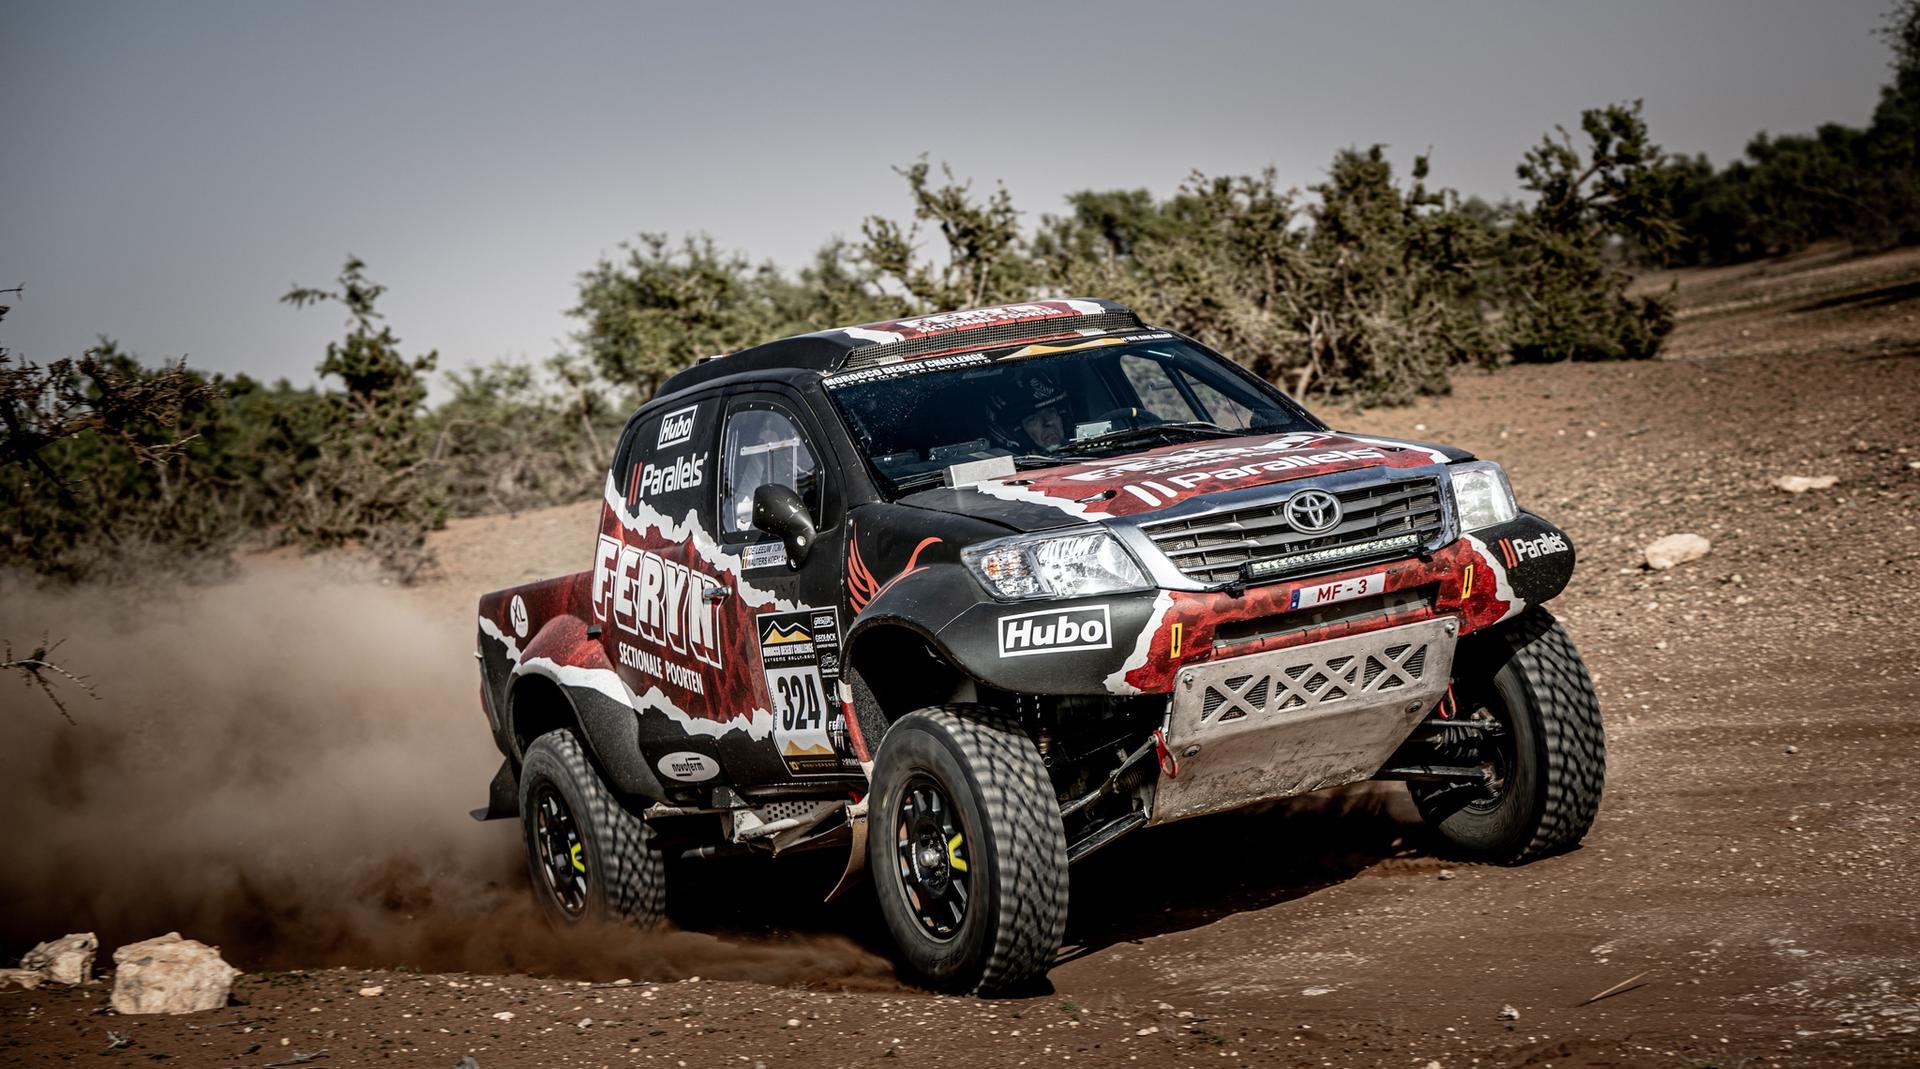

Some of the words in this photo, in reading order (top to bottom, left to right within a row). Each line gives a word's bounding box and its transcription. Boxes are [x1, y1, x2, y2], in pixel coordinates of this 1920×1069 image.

[821, 369, 883, 386] MOROCCO
[881, 361, 925, 375] DESERT
[924, 353, 988, 368] CHALLENGE
[660, 415, 692, 442] Hubo
[640, 452, 704, 498] Parallels
[1168, 447, 1384, 489] Parallels
[1512, 532, 1569, 562] Parallels
[592, 532, 723, 670] FERYN
[1005, 615, 1104, 649] Hubo
[618, 641, 663, 679] SECTIONALE
[665, 660, 705, 696] POORTEN
[777, 673, 821, 731] 324
